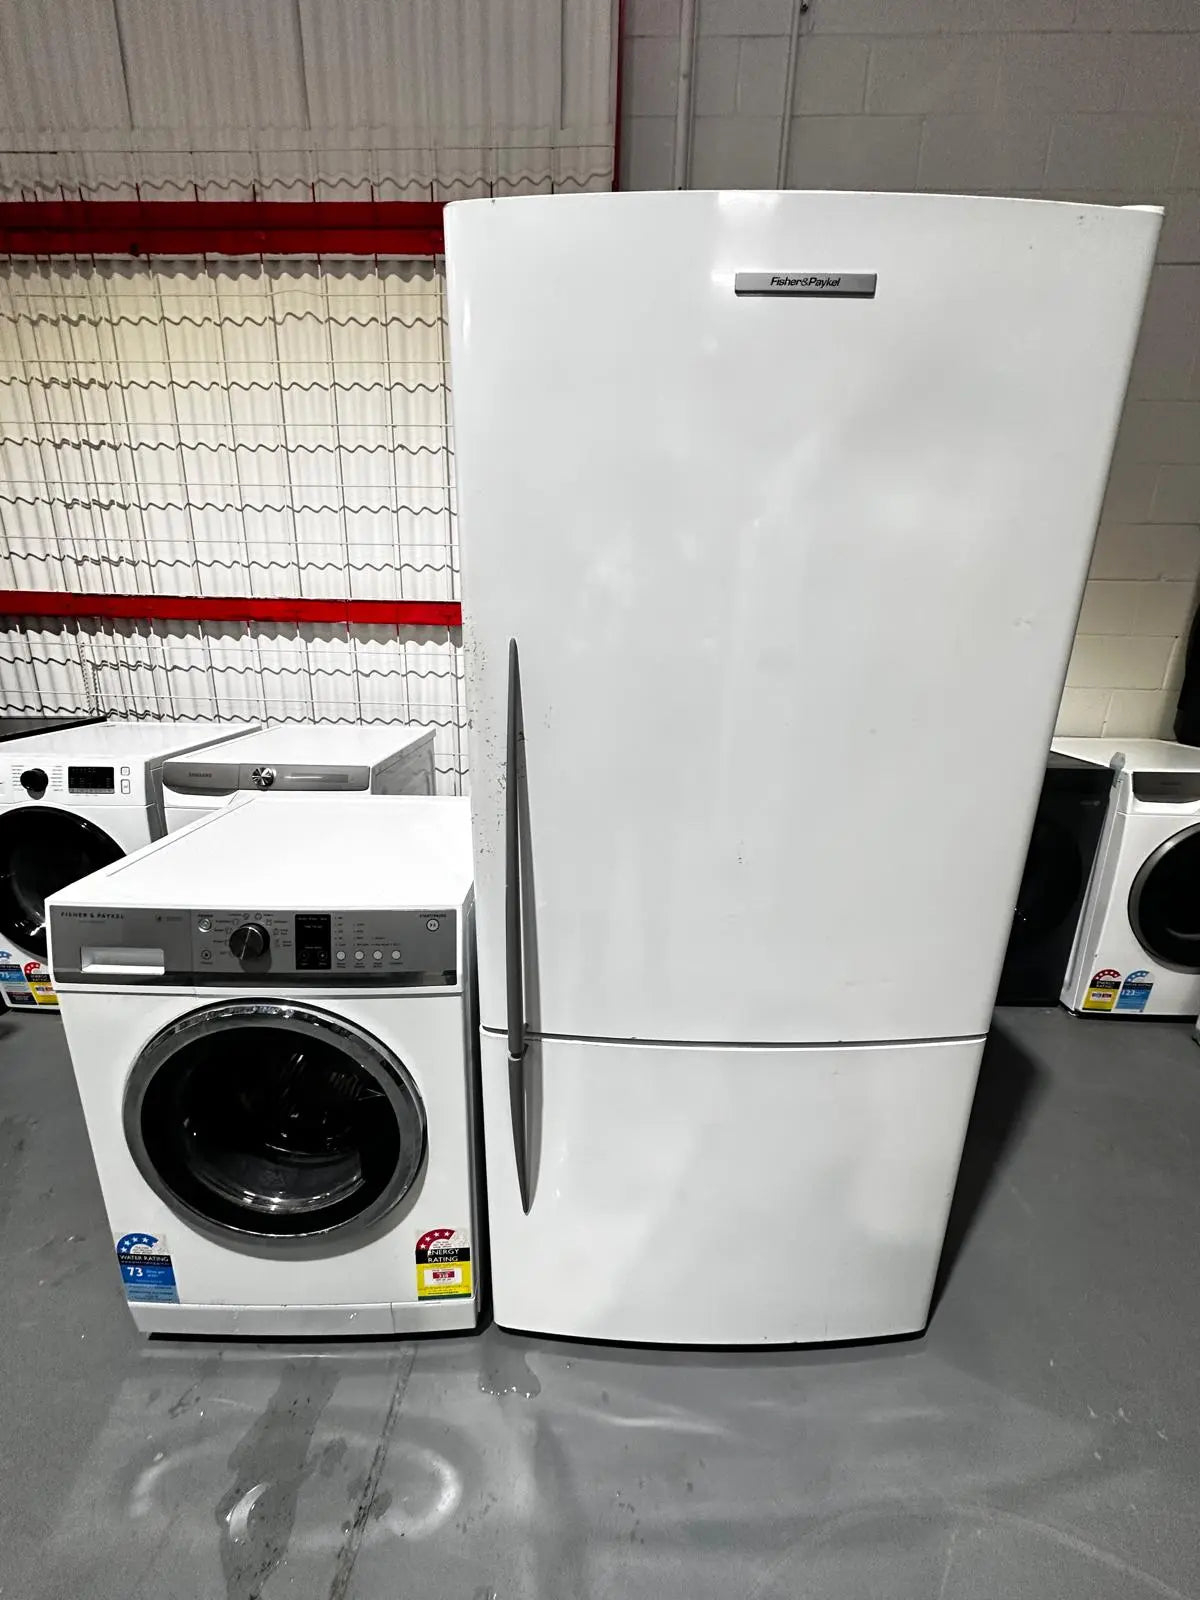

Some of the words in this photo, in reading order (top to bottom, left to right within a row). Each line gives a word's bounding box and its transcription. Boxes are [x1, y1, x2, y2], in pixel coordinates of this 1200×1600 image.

[770, 276, 841, 288] Fisher&Paykel
[427, 1248, 460, 1256] ENERGY
[126, 1266, 143, 1276] 73
